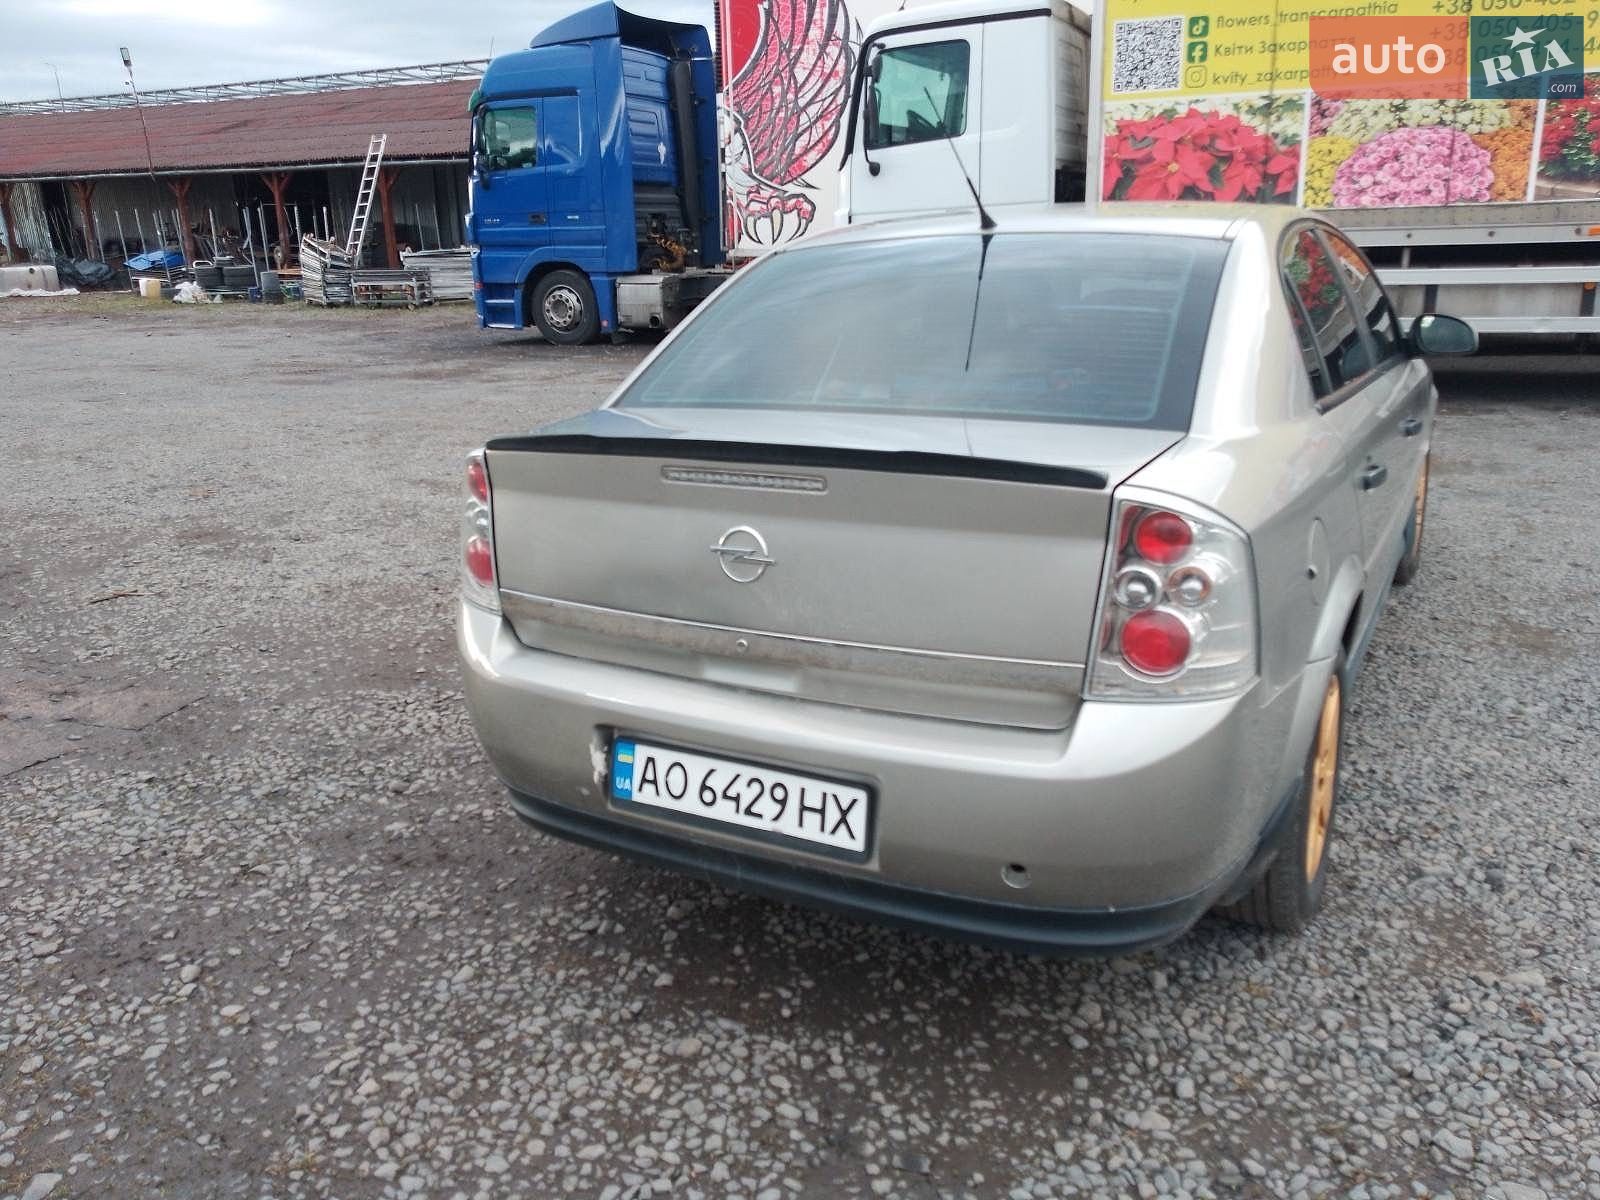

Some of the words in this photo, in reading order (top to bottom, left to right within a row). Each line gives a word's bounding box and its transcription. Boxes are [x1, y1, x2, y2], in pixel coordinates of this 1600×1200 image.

[1213, 42, 1253, 58] Квіти
[615, 776, 632, 791] UA
[638, 756, 688, 800] AO
[699, 768, 789, 822] 6429
[798, 787, 858, 841] HX
